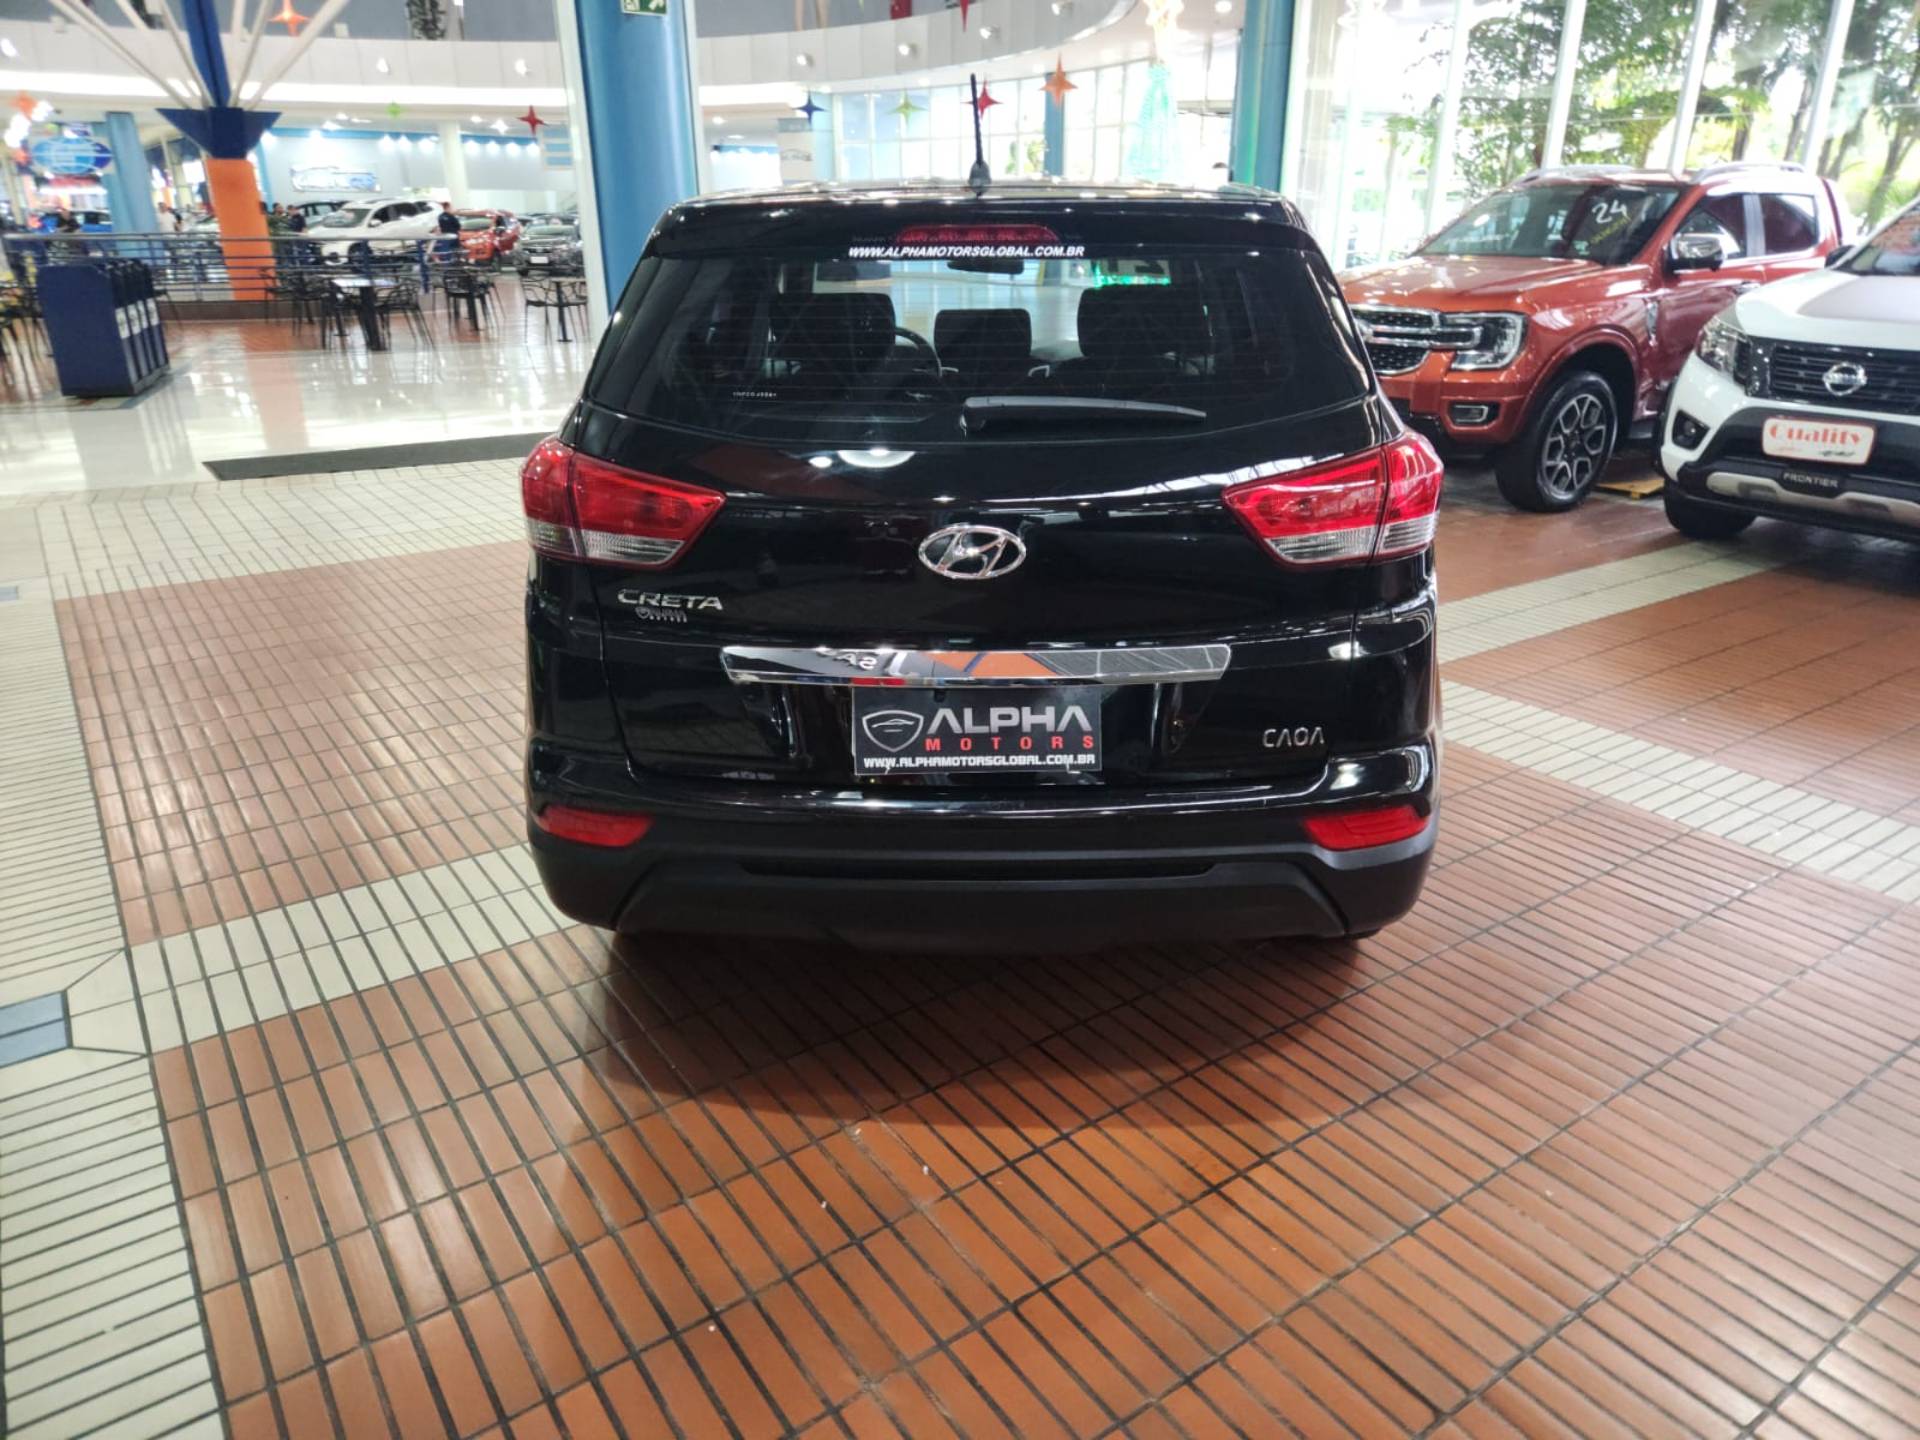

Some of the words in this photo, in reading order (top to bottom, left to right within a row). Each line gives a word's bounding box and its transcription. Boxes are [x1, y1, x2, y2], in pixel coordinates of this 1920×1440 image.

[1591, 199, 1631, 224] 24
[848, 245, 1085, 258] WWW.ALPHAMOTORSGLOBAL.COM.BR
[1783, 471, 1839, 488] FRONTIER
[617, 588, 724, 610] CRETA
[926, 705, 1093, 734] ALPHA
[924, 735, 1095, 752] MOTORS
[1262, 726, 1325, 748] CAOA
[863, 754, 1096, 769] WWW.ALPHAMOTORSGLOBAL.COM.BR
